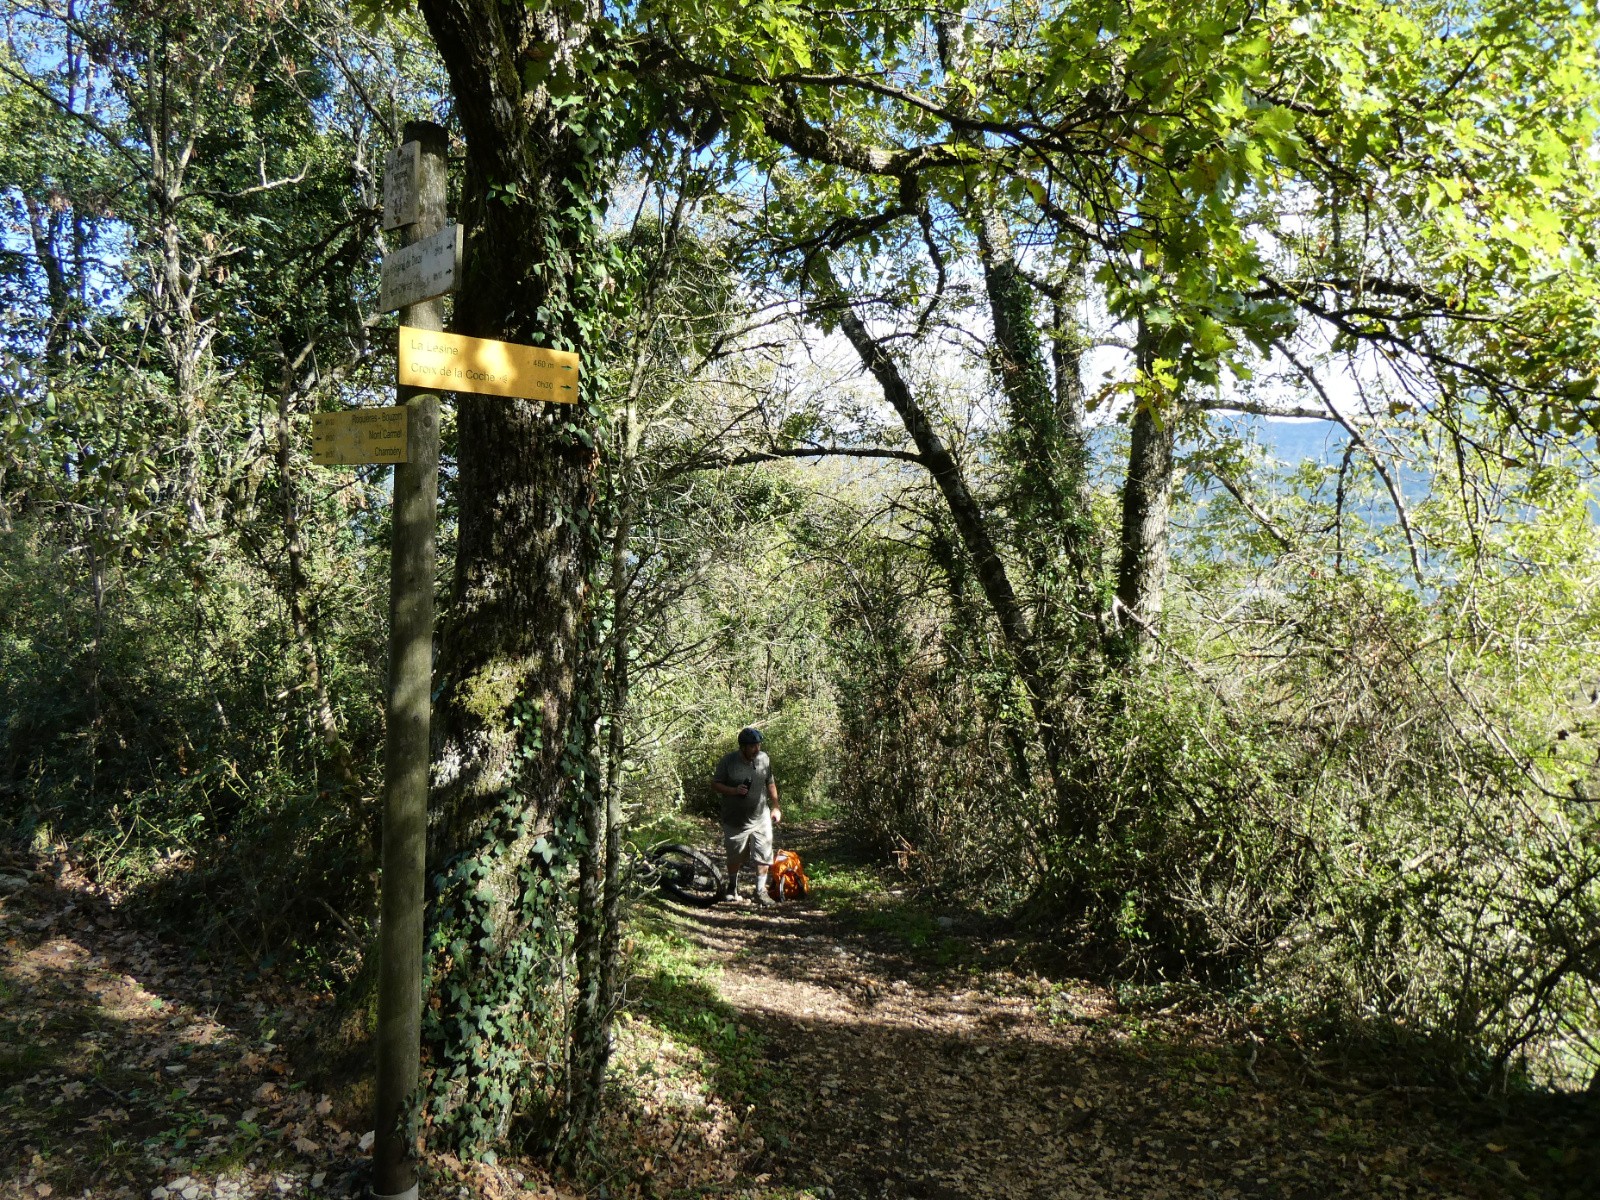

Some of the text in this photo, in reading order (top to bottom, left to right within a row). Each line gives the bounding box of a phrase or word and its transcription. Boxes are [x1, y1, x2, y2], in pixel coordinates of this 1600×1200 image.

[410, 362, 495, 382] Croix de la Coche
